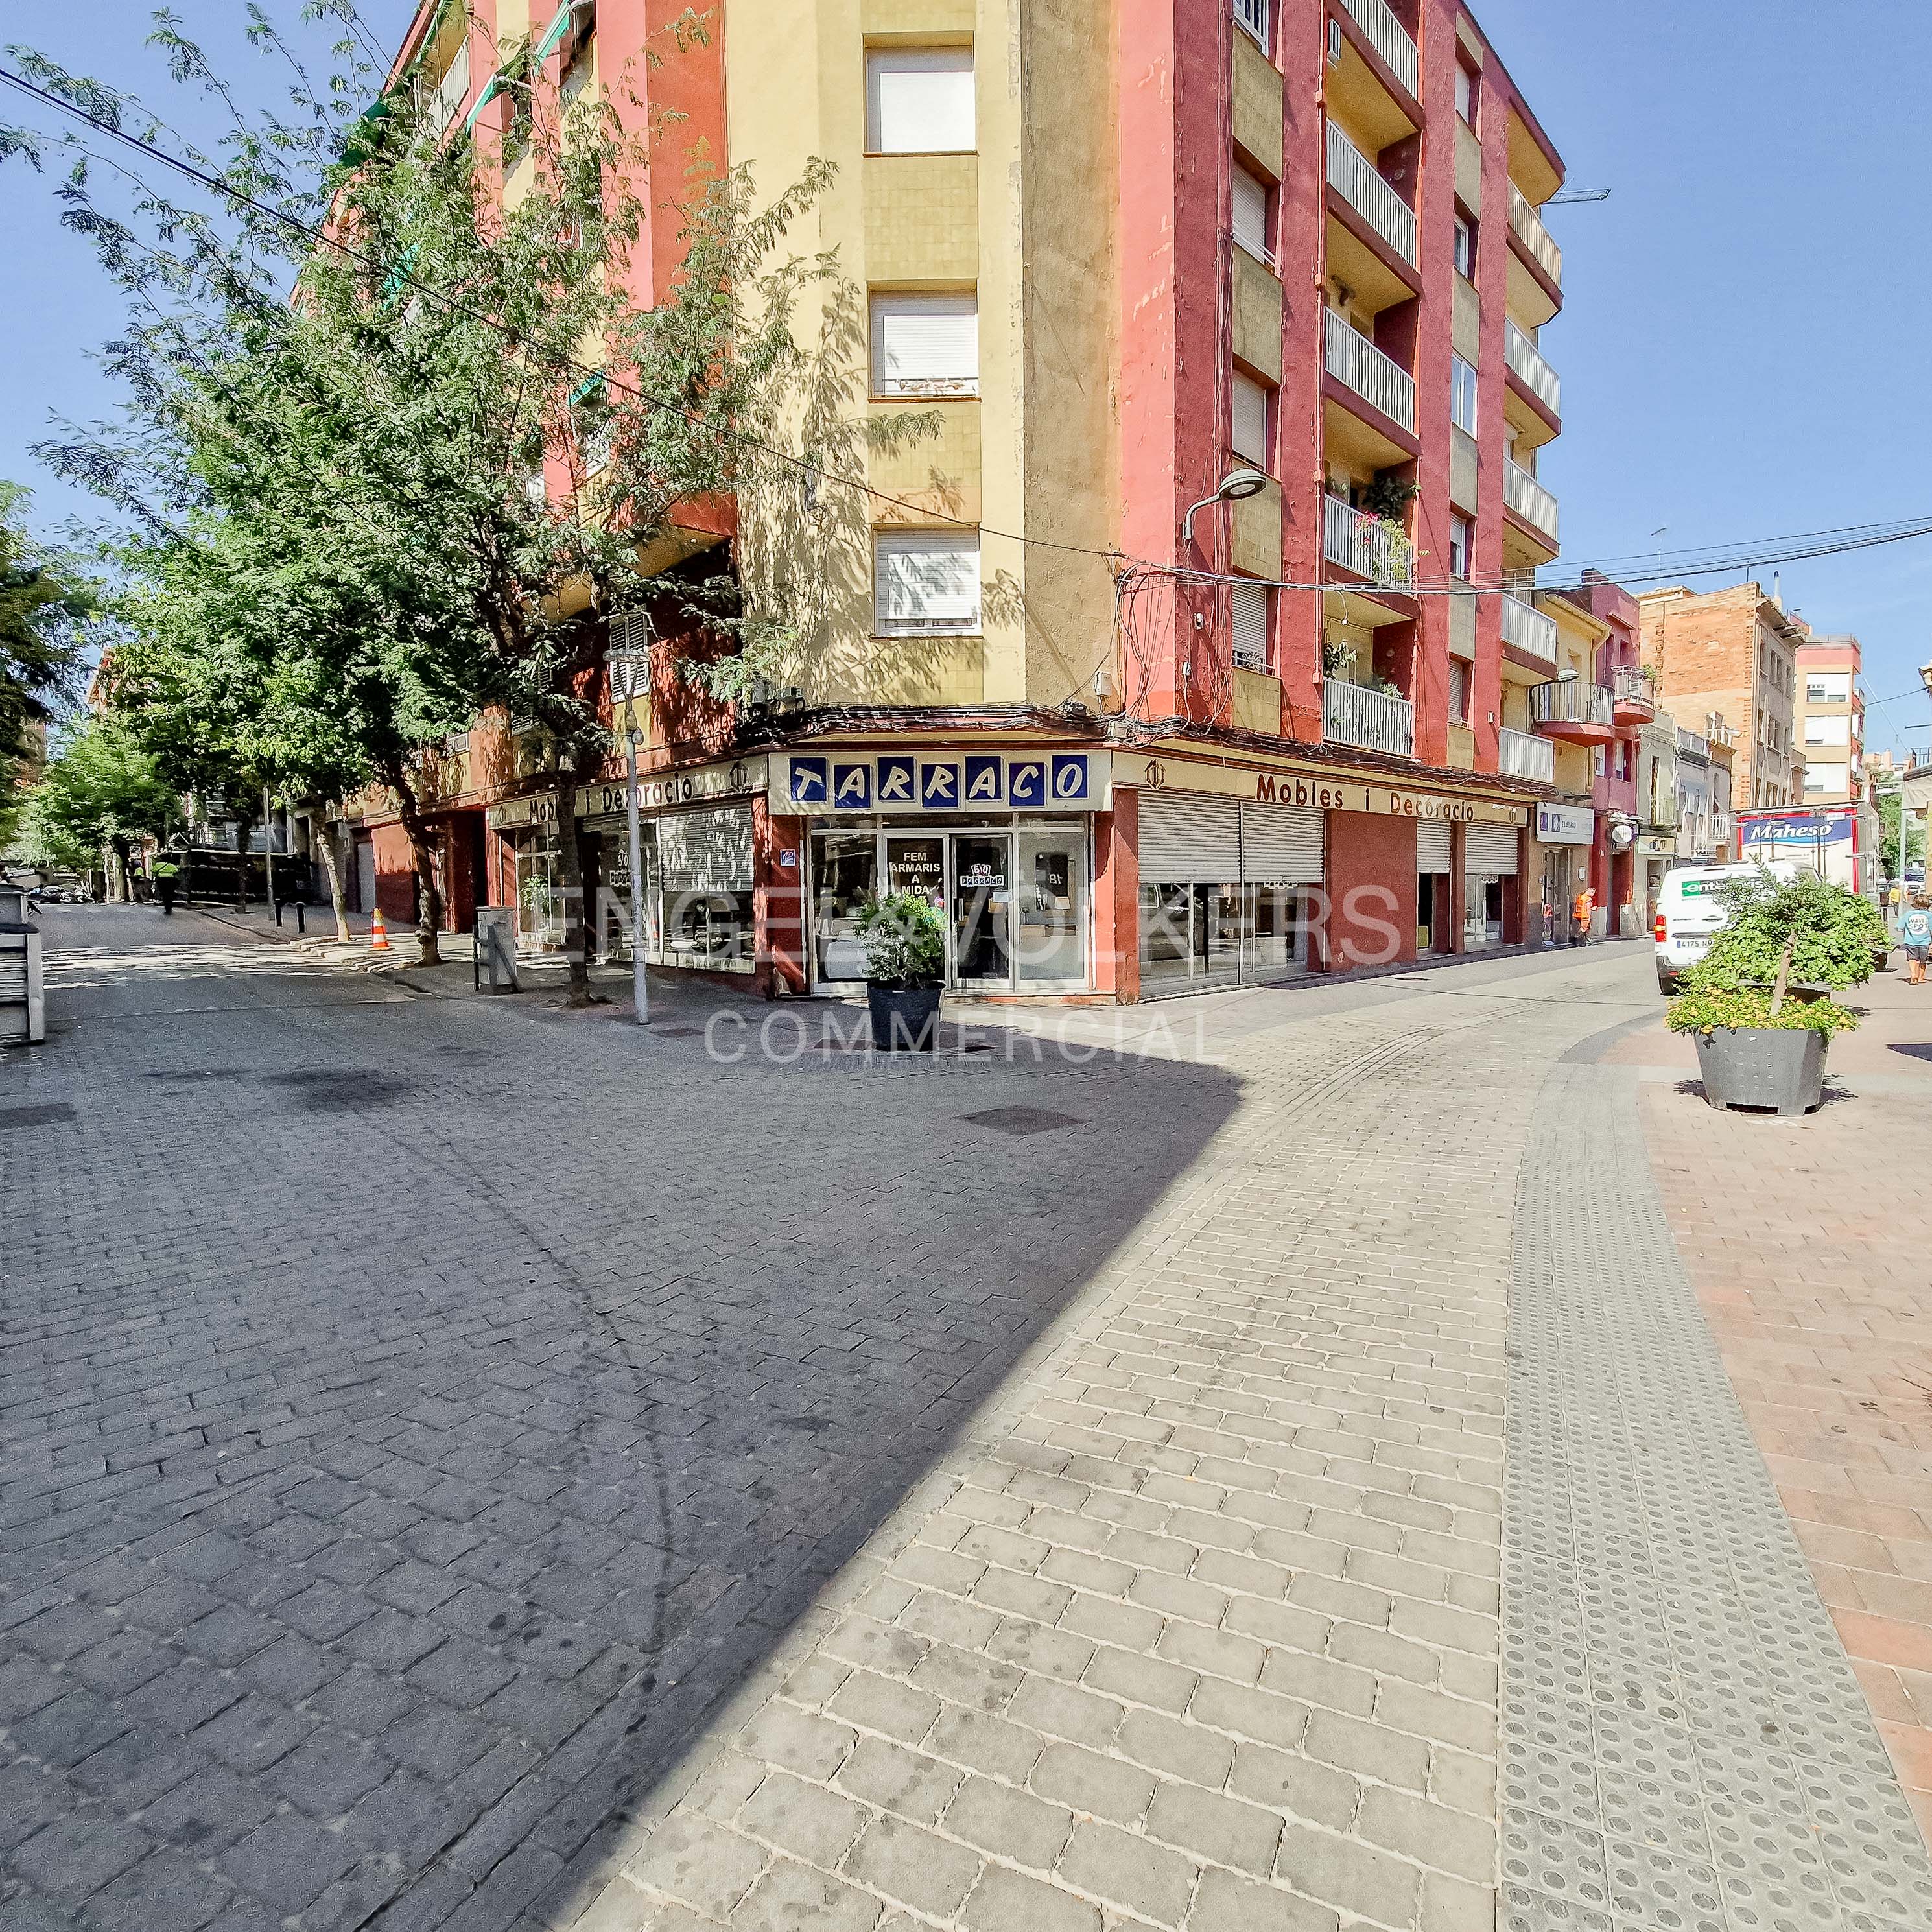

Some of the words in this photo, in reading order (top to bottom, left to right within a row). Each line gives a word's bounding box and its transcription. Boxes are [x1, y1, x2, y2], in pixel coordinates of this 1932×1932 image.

[795, 763, 1083, 800] TARRACO
[529, 795, 558, 822] Mobl
[585, 788, 591, 814] i
[602, 772, 693, 812] Deració
[1256, 774, 1343, 809] Mobles
[1365, 788, 1370, 811] i
[1390, 792, 1474, 821] Decoració
[1750, 823, 1833, 840] Maheso
[904, 852, 926, 862] FEM
[891, 863, 941, 873] ARMARIS
[973, 865, 989, 875] 50
[911, 874, 920, 884] A
[902, 885, 930, 895] MIDA
